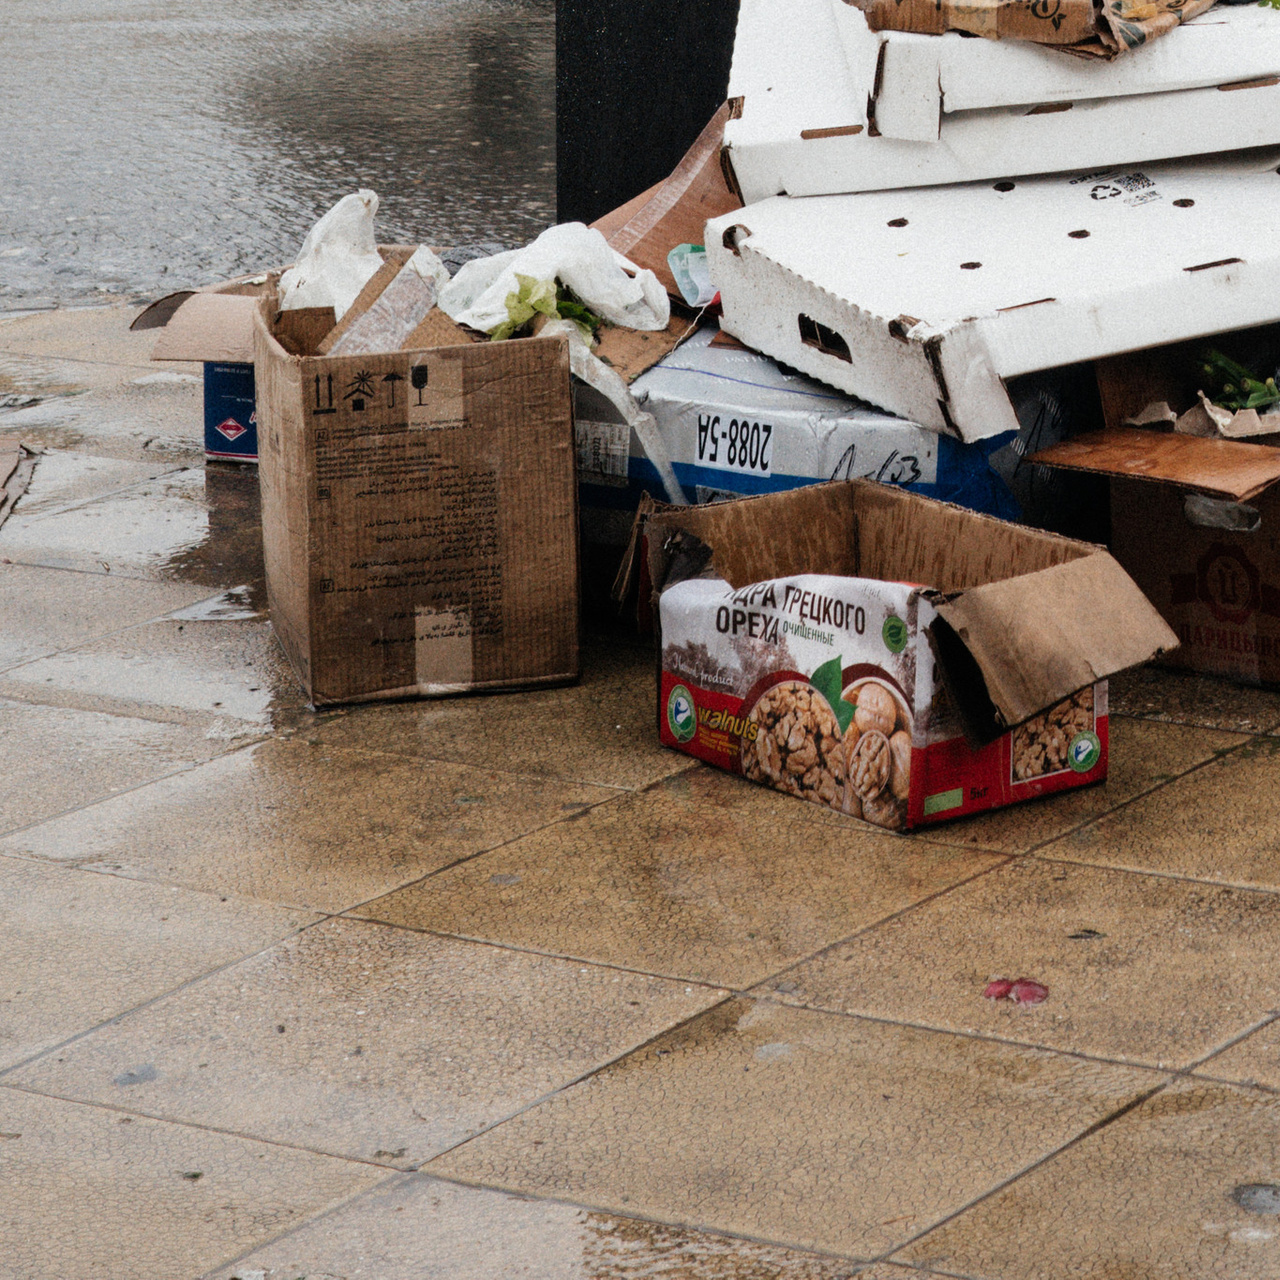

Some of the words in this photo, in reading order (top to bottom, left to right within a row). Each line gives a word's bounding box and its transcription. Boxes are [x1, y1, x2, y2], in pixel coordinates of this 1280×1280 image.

[698, 414, 772, 471] 2088-5A
[716, 606, 779, 646] ОРЕХА
[782, 585, 866, 635] ГРЕЦКОГО
[782, 620, 836, 647] ОЧИЩЕННЫЕ
[699, 667, 735, 688] product
[697, 705, 760, 741] walnuts
